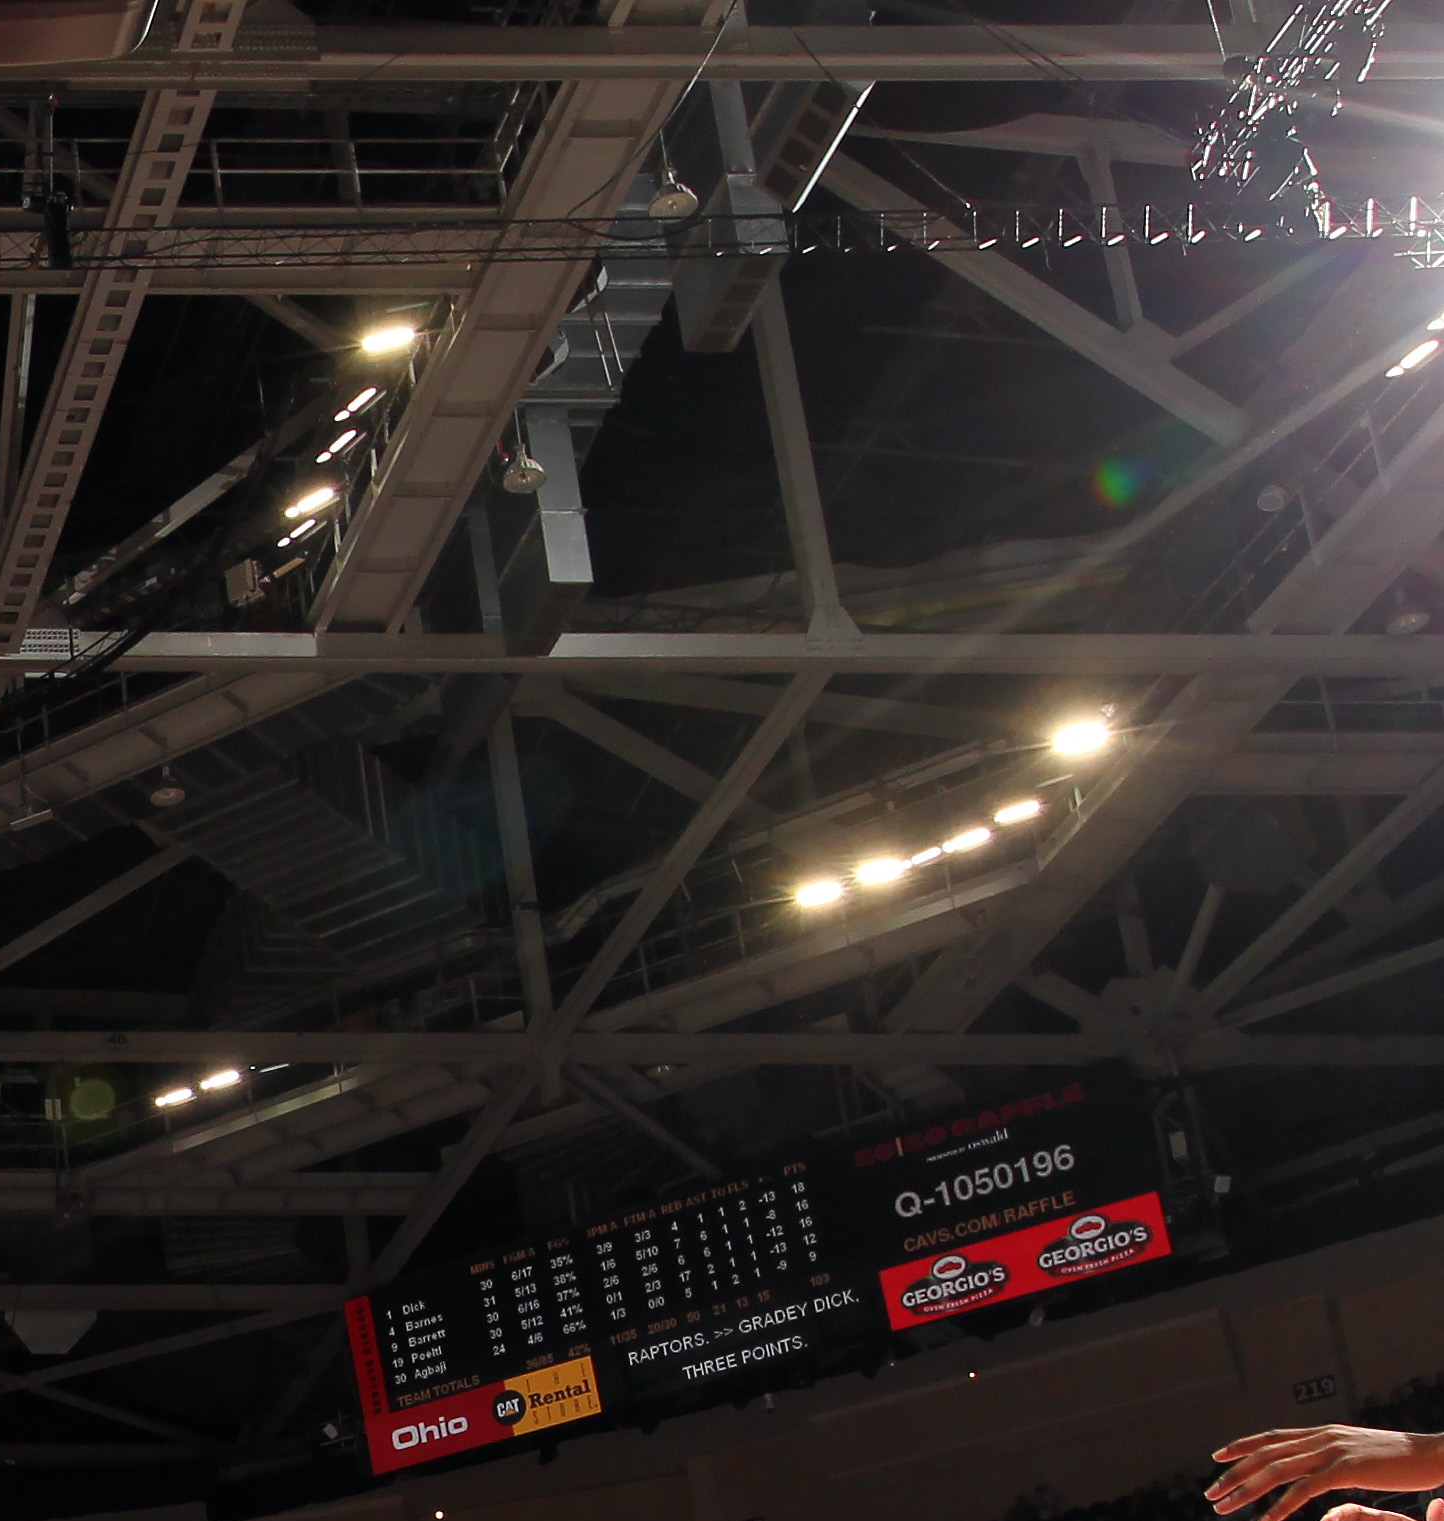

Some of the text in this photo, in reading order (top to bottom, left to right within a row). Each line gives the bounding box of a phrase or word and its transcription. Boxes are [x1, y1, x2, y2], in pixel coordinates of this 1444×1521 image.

[894, 1144, 1075, 1217] Q-1050196
[1038, 1227, 1148, 1269] GEORGIO'S
[901, 1267, 1007, 1307] GEORGIO'S
[405, 1313, 445, 1332] Barnes
[408, 1328, 447, 1348] Barrett
[627, 1288, 861, 1366] RAPTORS. GRADEY DICK.
[414, 1360, 448, 1381] Agbaji
[681, 1334, 810, 1381] THREE POINTS.
[397, 1374, 481, 1408] TEAM TOTALS
[496, 1378, 592, 1419] CAT Rental
[391, 1415, 469, 1451] Ohio
